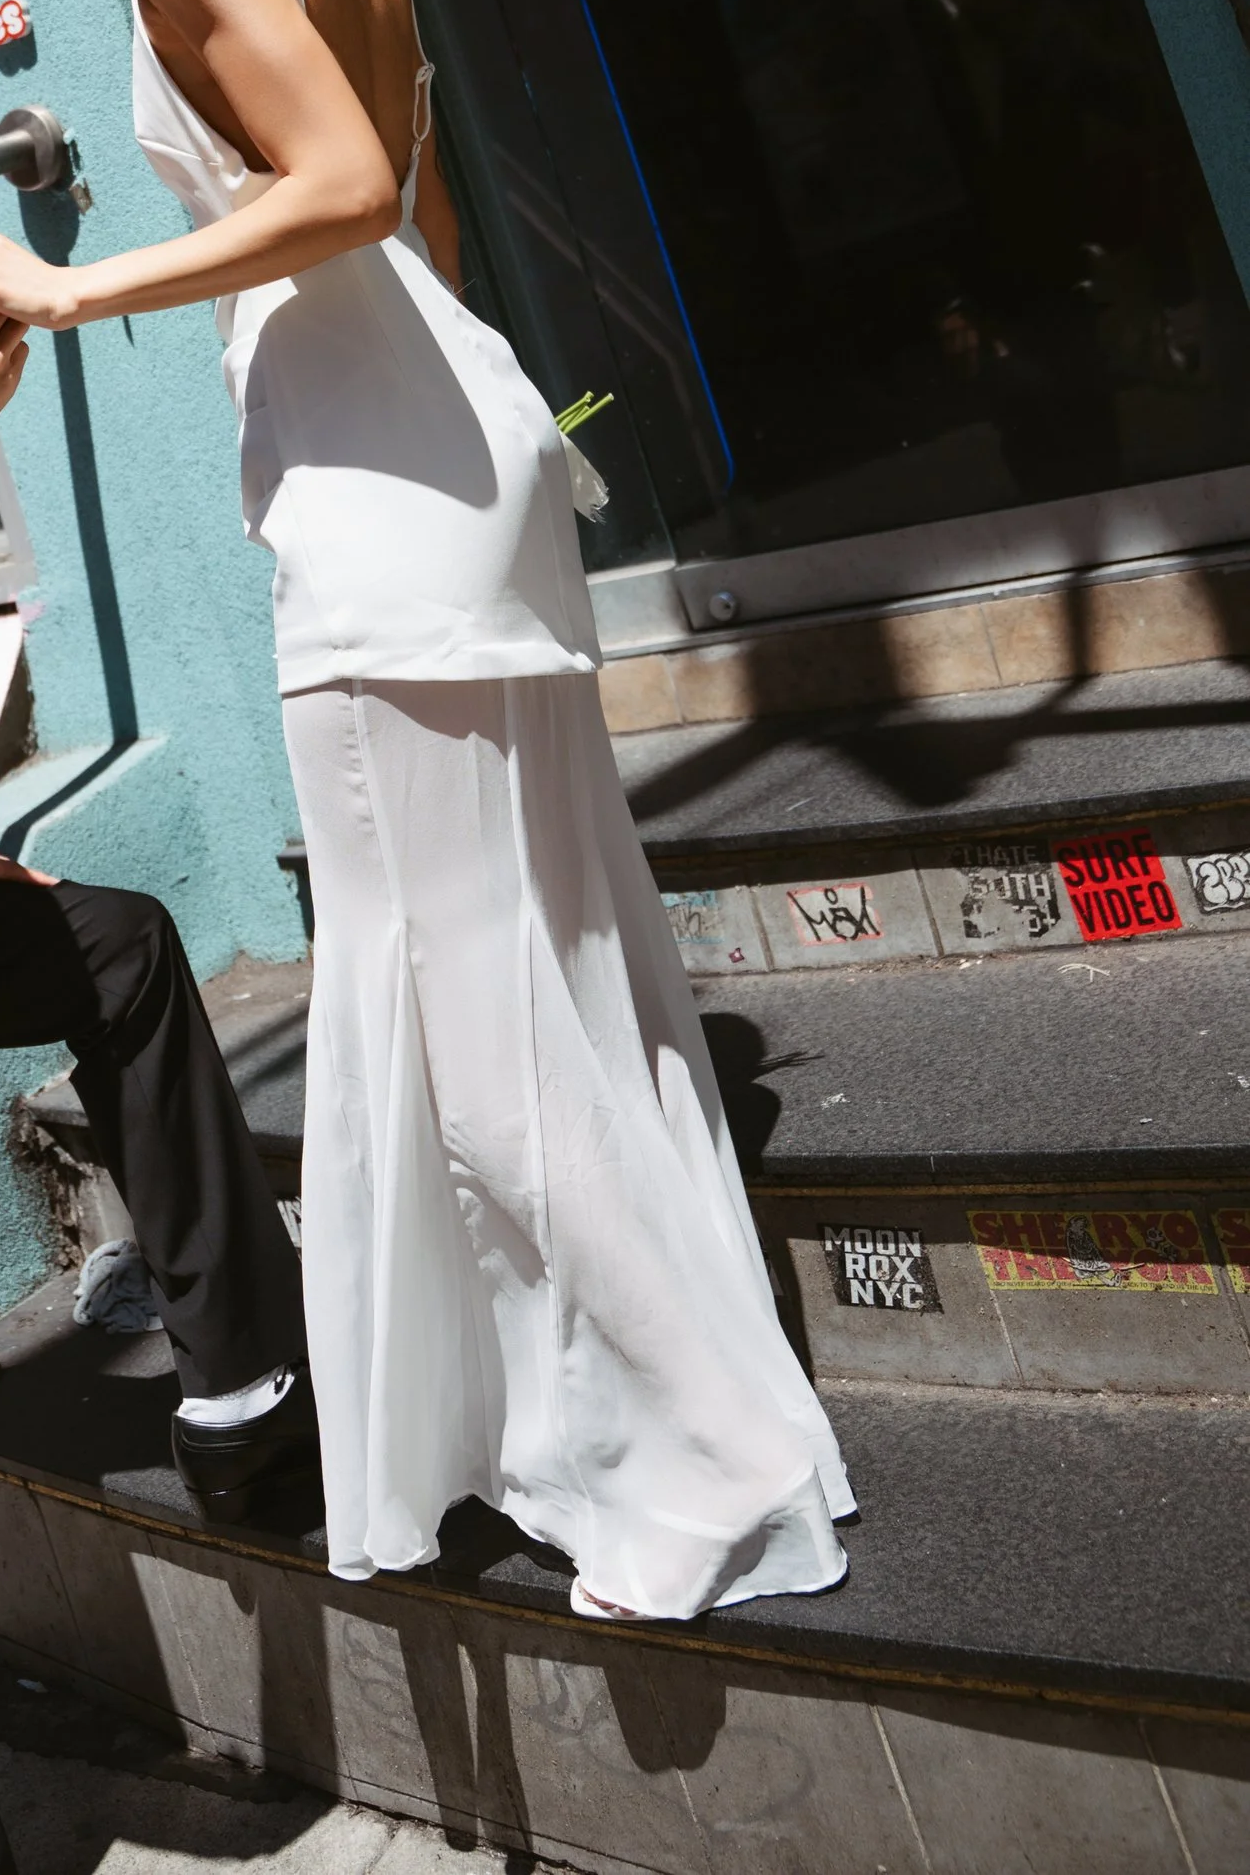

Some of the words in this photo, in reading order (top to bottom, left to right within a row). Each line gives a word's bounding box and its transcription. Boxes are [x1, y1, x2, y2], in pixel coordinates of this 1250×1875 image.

[1057, 833, 1154, 888] SURF
[1070, 882, 1176, 935] VIDEO
[823, 1226, 921, 1258] MOON
[845, 1253, 916, 1283] ROX
[850, 1279, 924, 1309] NYC
